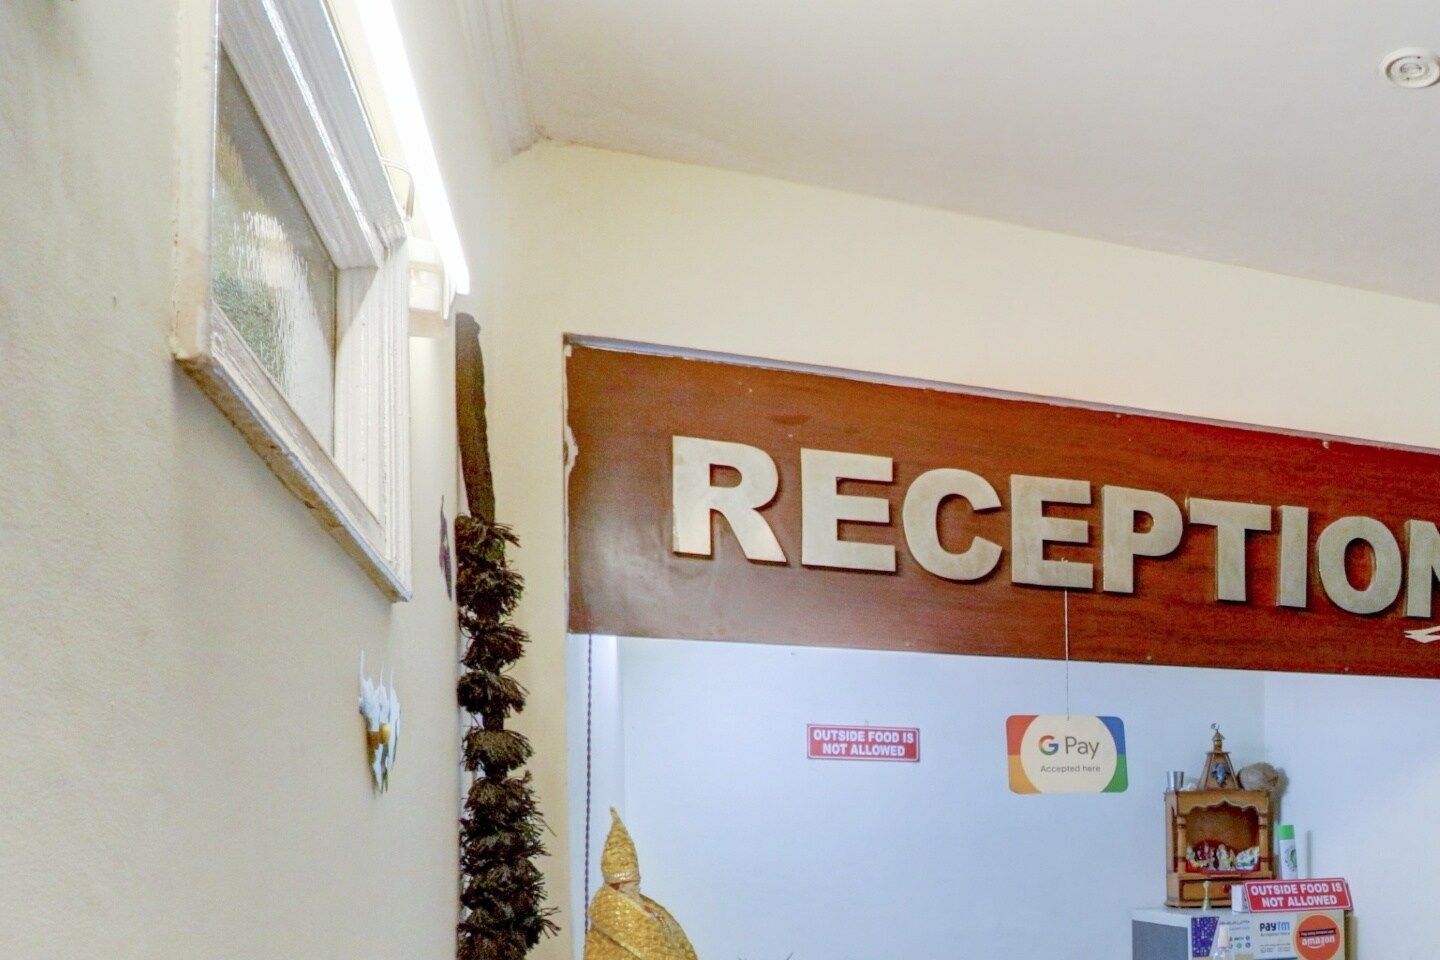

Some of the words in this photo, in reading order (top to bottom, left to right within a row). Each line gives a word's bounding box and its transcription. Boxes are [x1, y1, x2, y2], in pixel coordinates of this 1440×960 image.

[813, 729, 865, 742] OUTSIDE
[867, 731, 900, 743] FOOD
[902, 733, 914, 743] IS
[822, 743, 848, 755] NOT
[850, 745, 906, 756] ALLOWED
[1039, 735, 1059, 755] G
[1065, 736, 1100, 759] Pay
[1040, 765, 1080, 773] Accepted
[1250, 884, 1298, 896] OUTSIDE
[1300, 883, 1329, 894] FOOD
[1331, 882, 1343, 892] IS
[1261, 897, 1284, 908] NOT
[1287, 895, 1338, 907] ALLOWED
[1301, 935, 1335, 946] amazon
